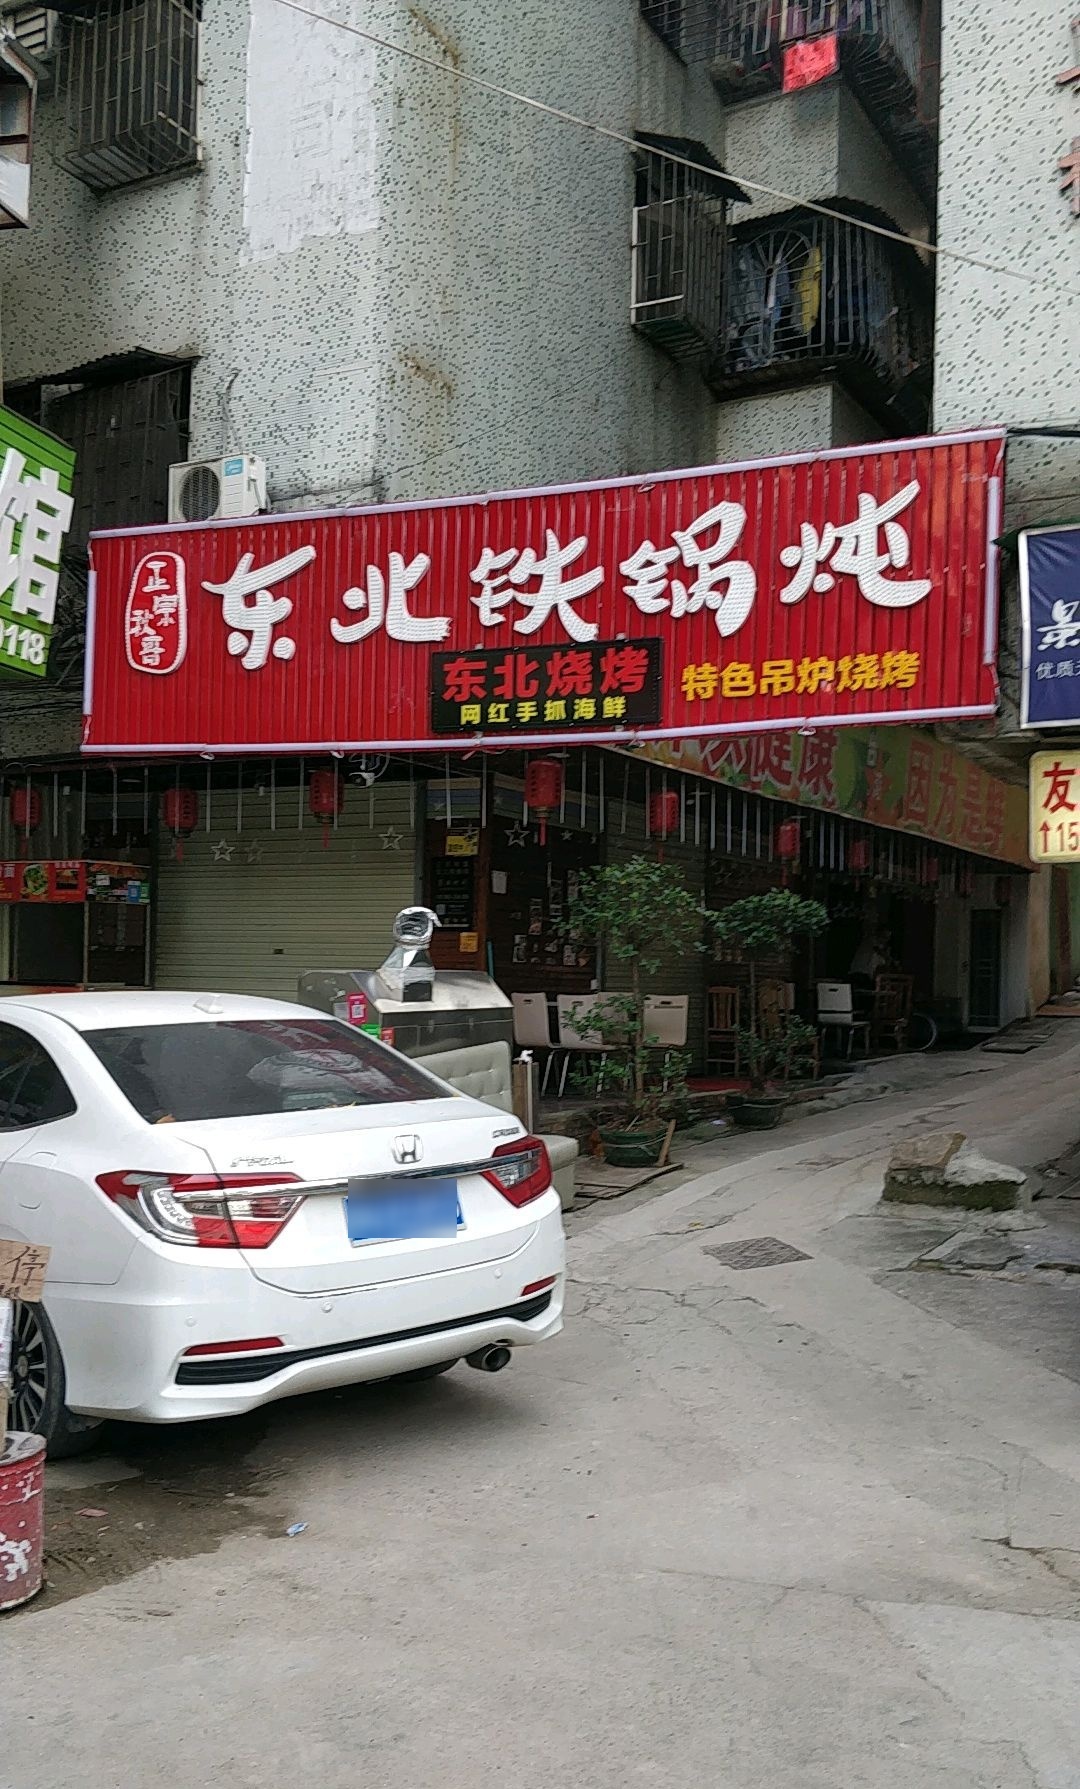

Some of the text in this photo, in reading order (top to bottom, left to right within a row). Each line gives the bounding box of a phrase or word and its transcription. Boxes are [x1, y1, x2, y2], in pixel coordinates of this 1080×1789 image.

[0, 448, 74, 624] 馆
[201, 479, 933, 670] 东北铁锅炖
[441, 646, 649, 702] 东北烧烤
[681, 650, 920, 701] 特色吊炉烧烤
[460, 696, 627, 725] 网红手抓海鲜
[1043, 762, 1075, 813] 友
[4, 1246, 47, 1286] 停
